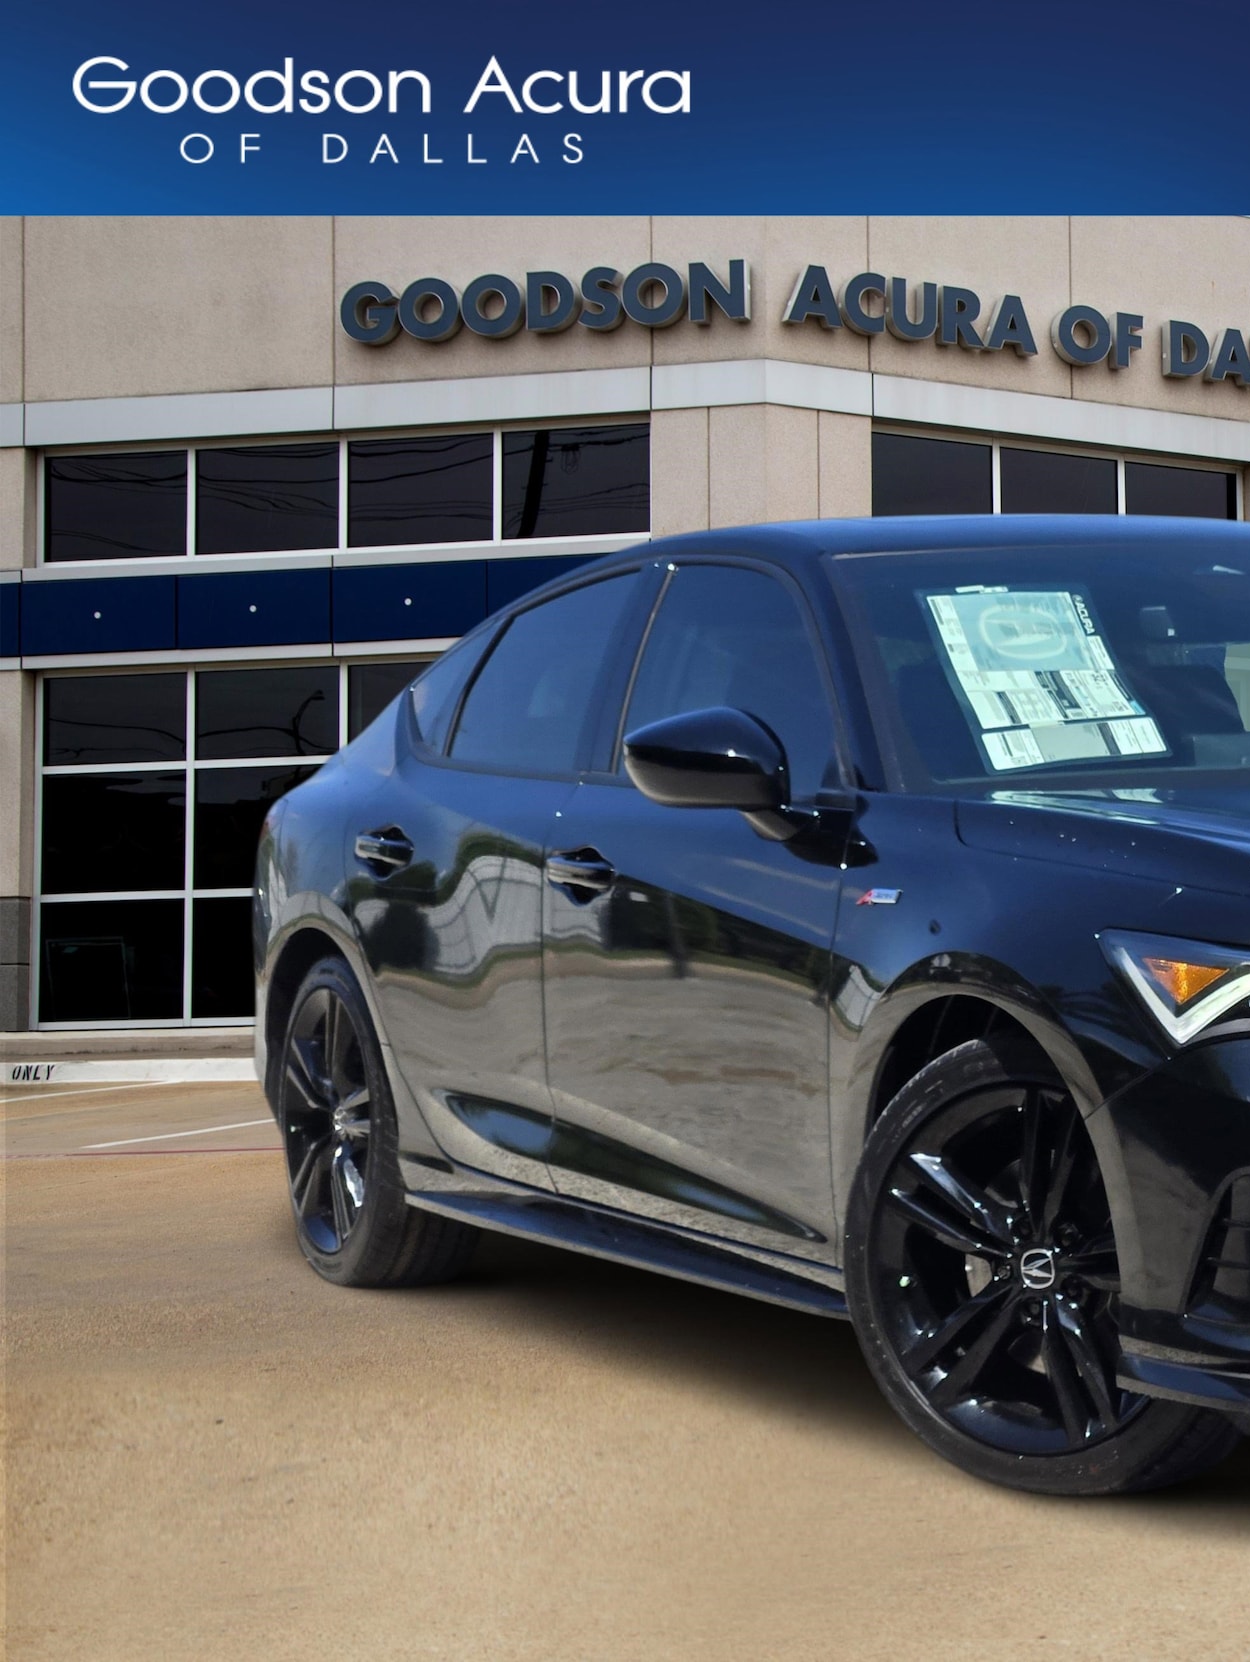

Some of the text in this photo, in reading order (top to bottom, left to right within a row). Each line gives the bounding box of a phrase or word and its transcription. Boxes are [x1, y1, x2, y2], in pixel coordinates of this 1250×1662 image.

[340, 259, 752, 345] GOODSON
[783, 264, 1039, 357] ACURA
[1051, 304, 1144, 370] OF
[1074, 602, 1096, 635] ACURA
[11, 1064, 55, 1081] ONLY
